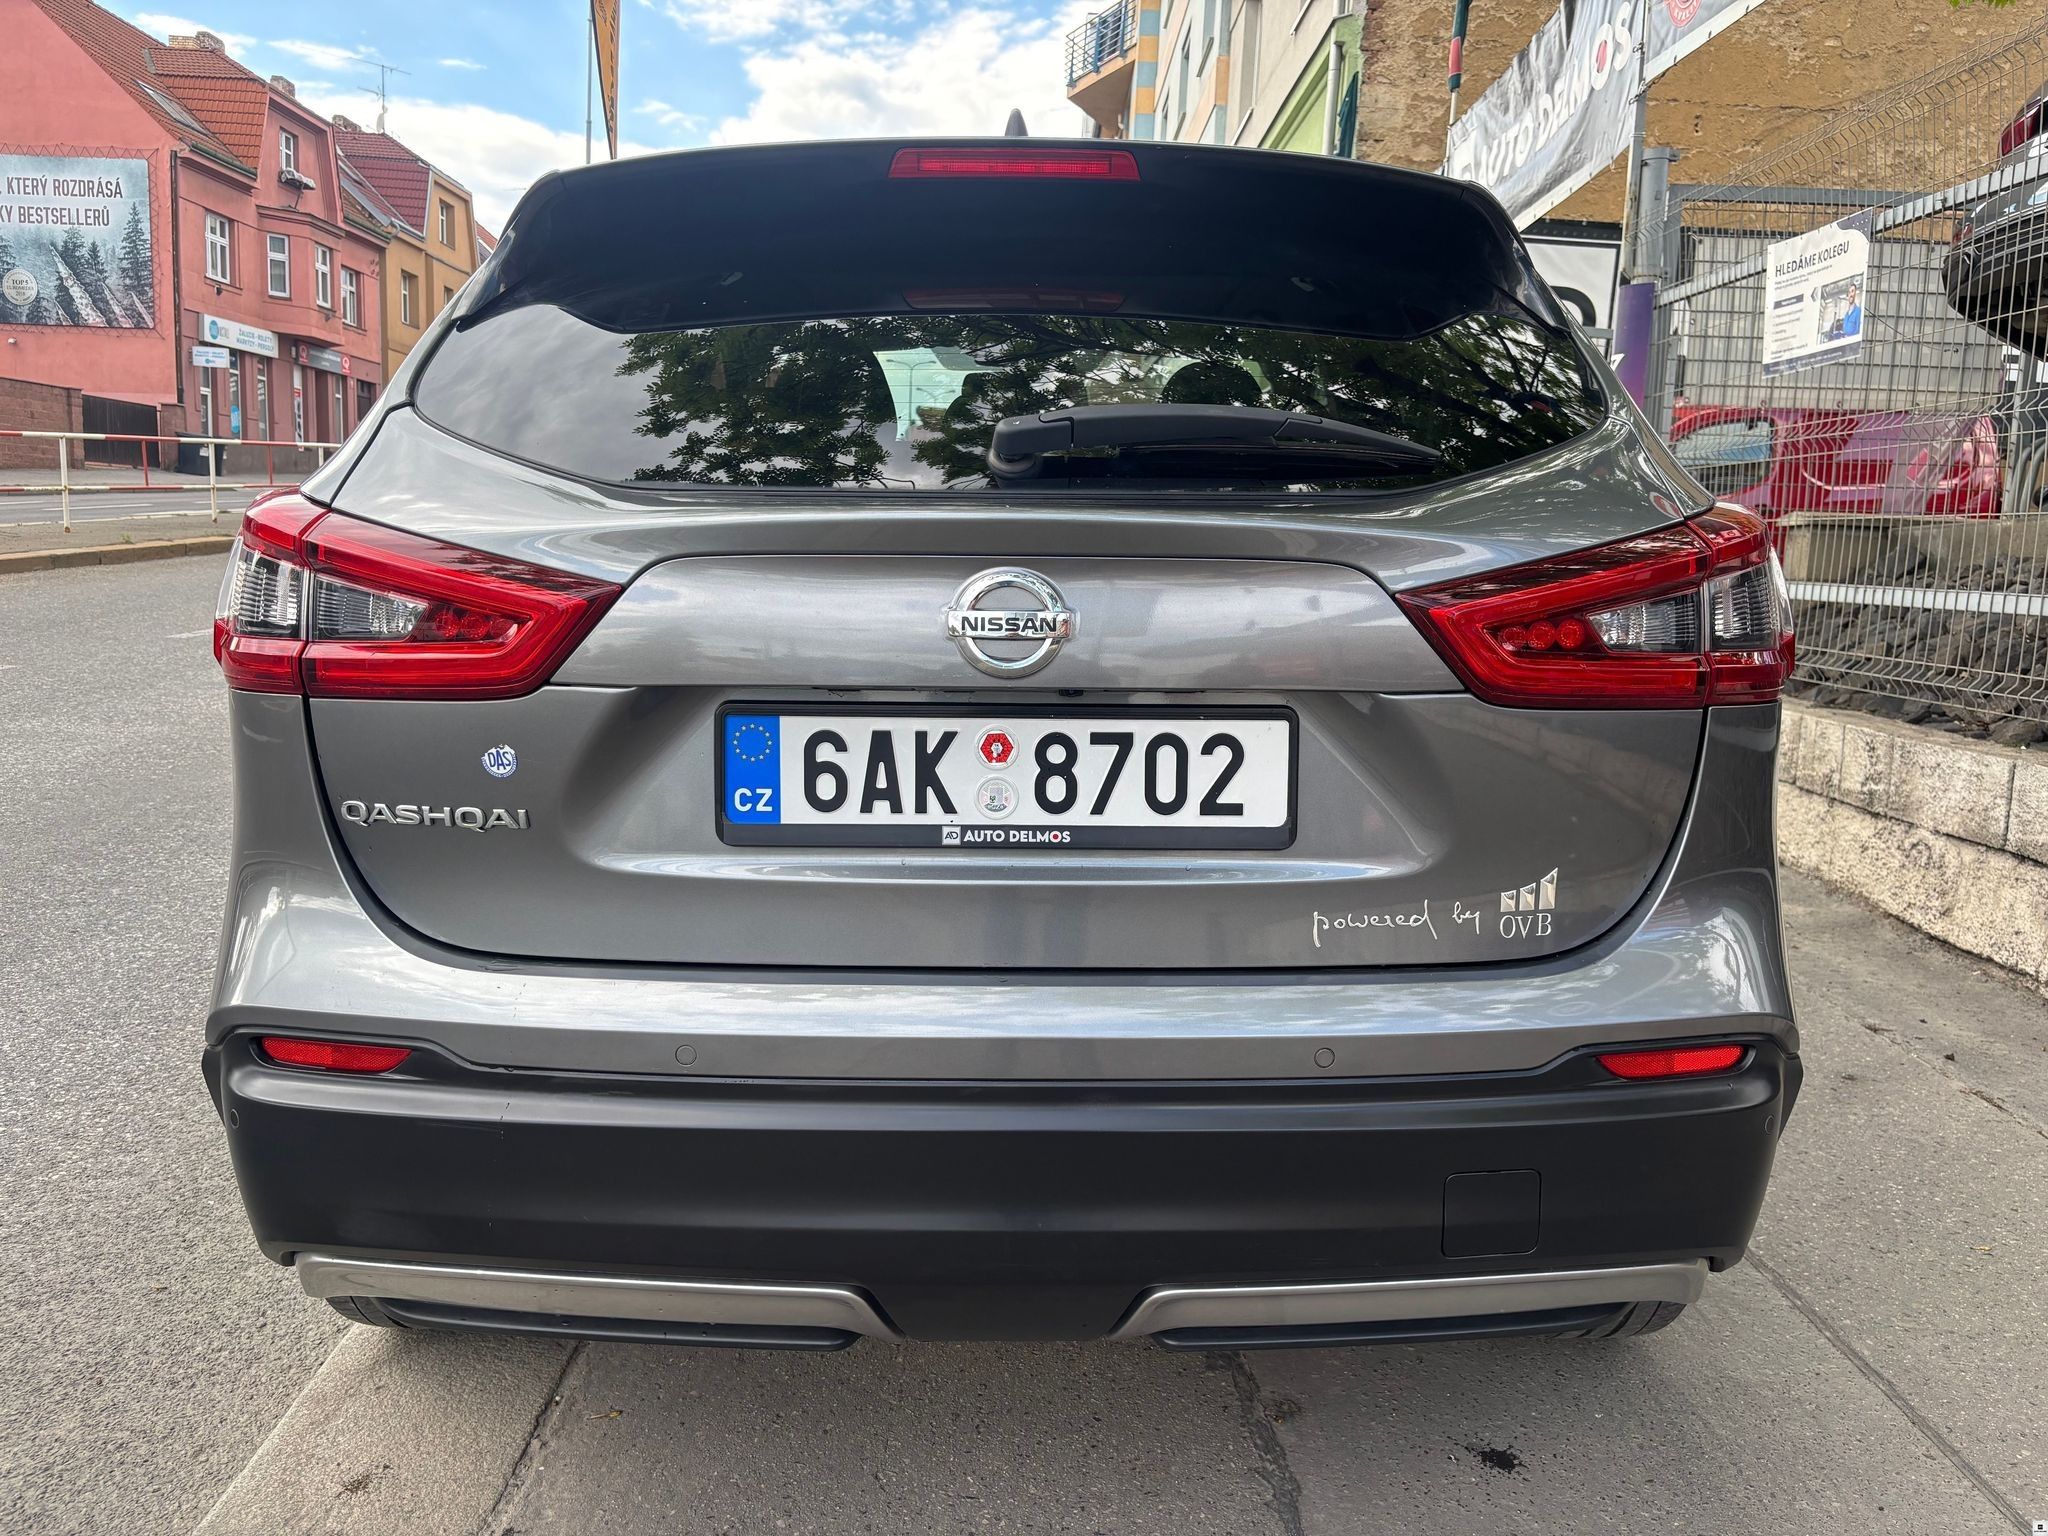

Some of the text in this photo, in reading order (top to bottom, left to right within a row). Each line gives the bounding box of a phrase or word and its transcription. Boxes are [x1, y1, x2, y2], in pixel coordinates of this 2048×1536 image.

[6, 175, 123, 198] KTERÝ ROZDRÁSÁ
[18, 205, 110, 227] BESTSELLERŮ
[1774, 252, 1817, 278] HLEDÁME
[1817, 240, 1850, 264] KOLEGU
[961, 616, 1057, 633] NISSAN
[487, 750, 512, 771] DAS
[803, 729, 1245, 817] 6AK 8702
[733, 788, 774, 813] CZ
[340, 800, 530, 833] QASHQAI
[963, 830, 1071, 843] AUTO DELMOS
[1312, 899, 1480, 948] powered by
[1499, 912, 1552, 939] OVB
